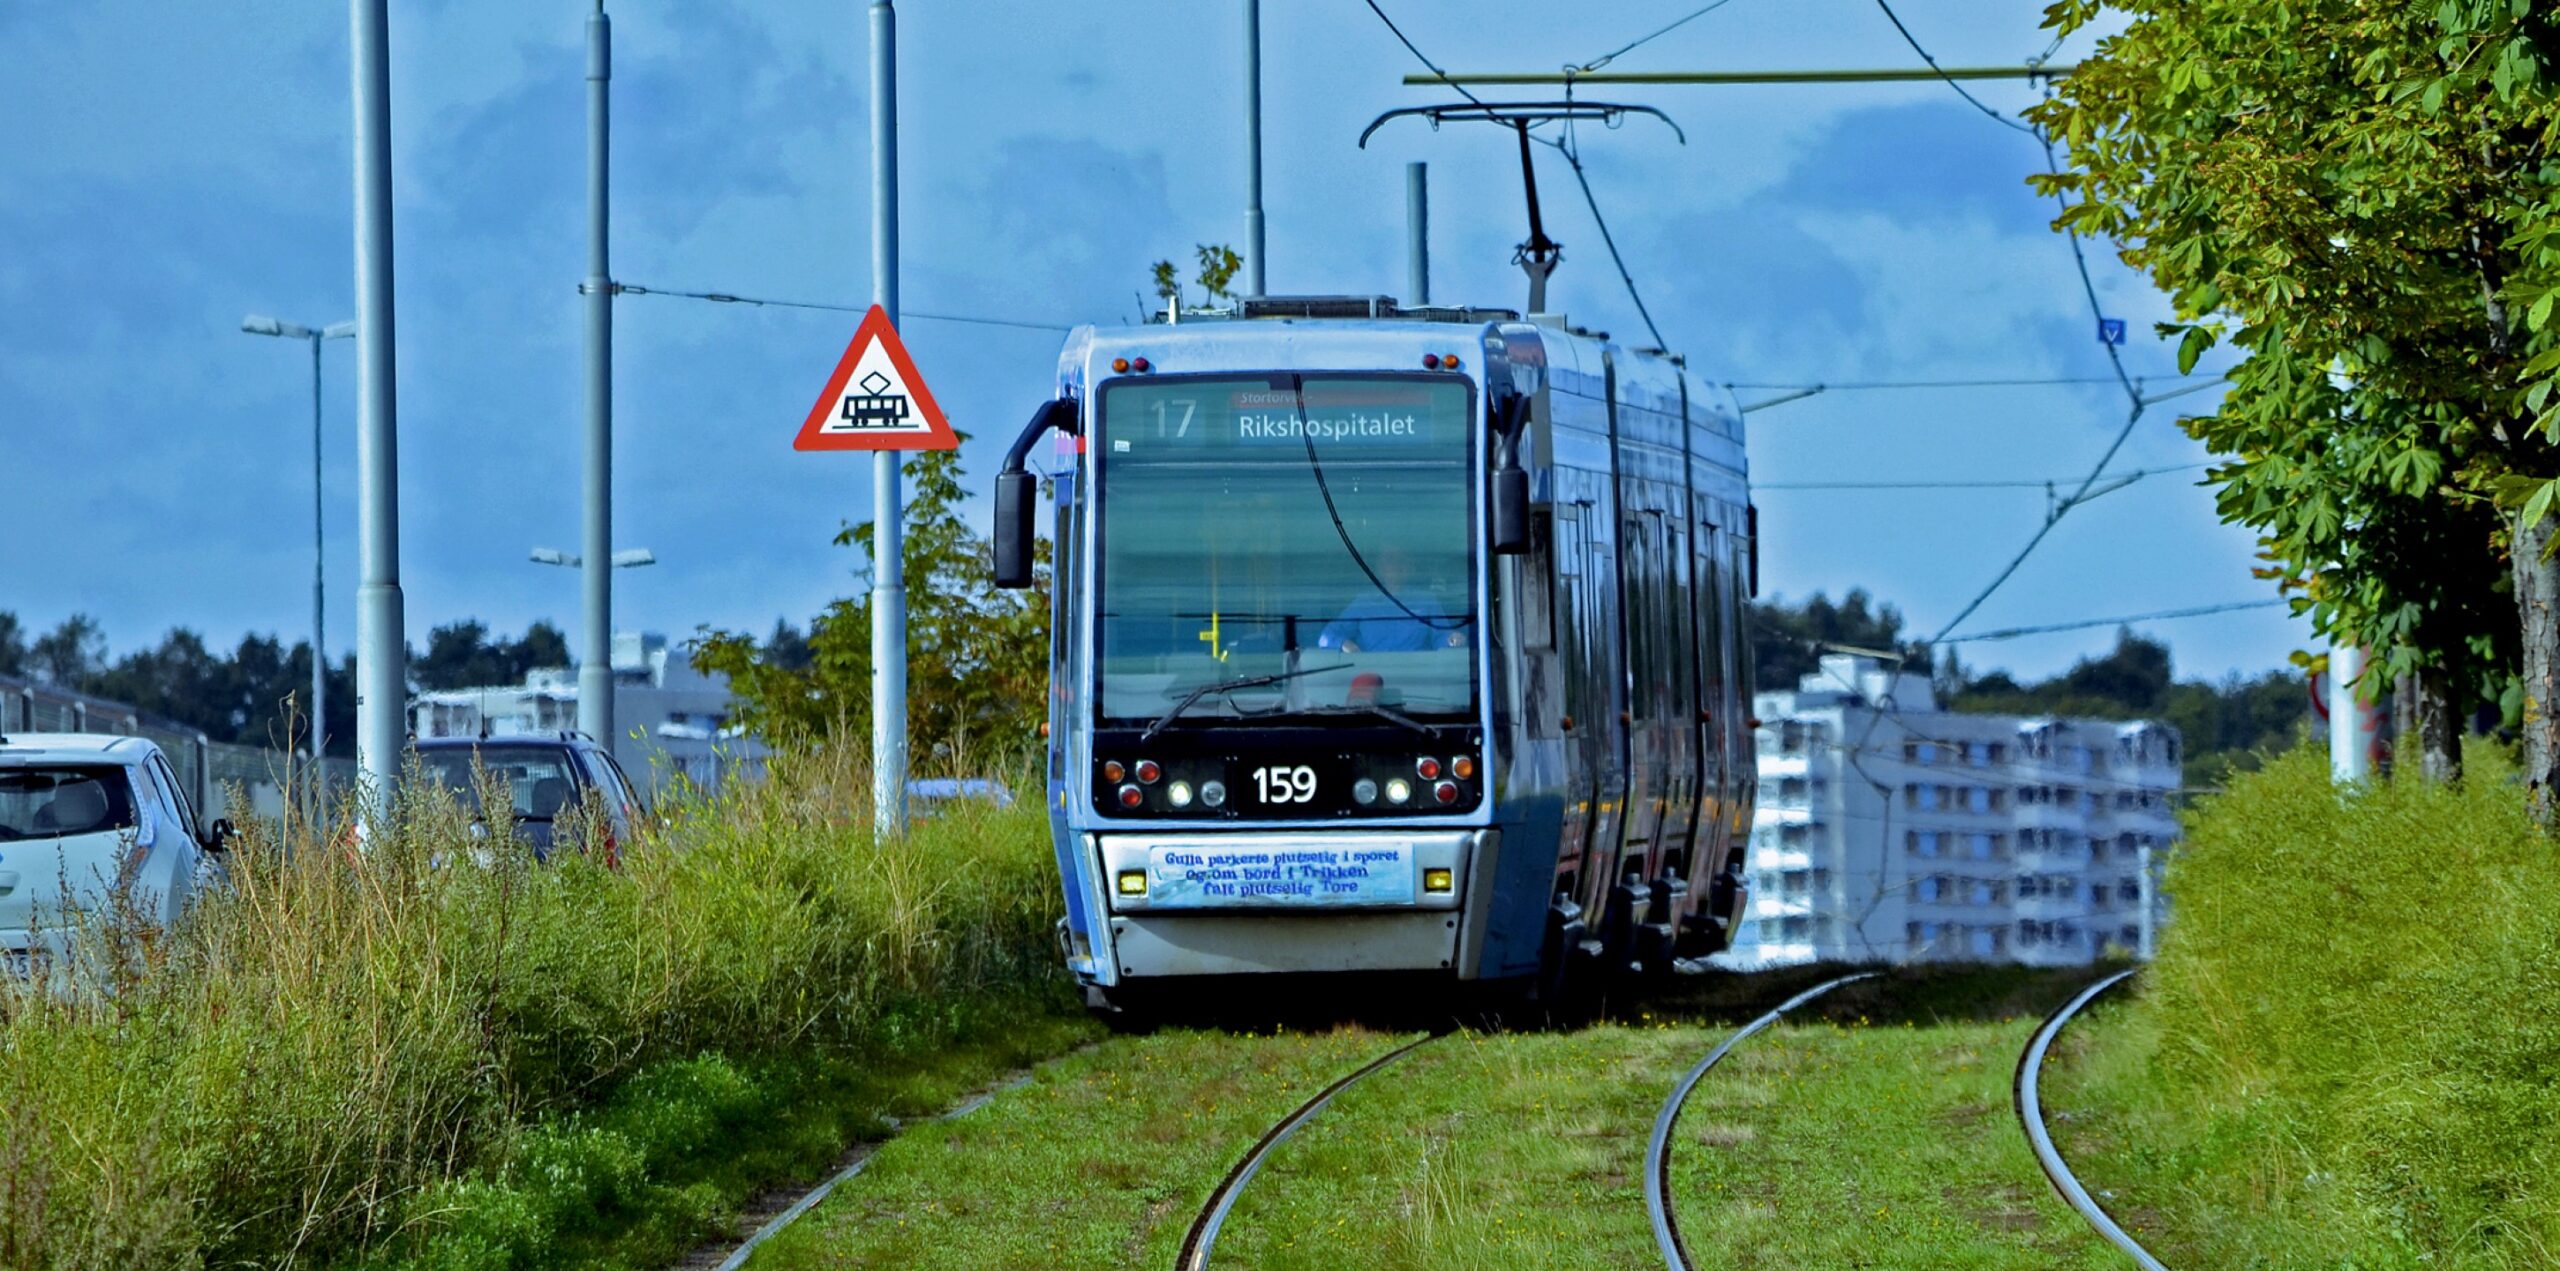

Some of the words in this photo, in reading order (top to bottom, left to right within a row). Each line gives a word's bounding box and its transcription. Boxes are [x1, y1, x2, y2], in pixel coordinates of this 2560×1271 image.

[1151, 399, 1197, 438] 17
[1239, 412, 1416, 442] Rikshospitalet
[1253, 765, 1317, 804] 159
[1208, 854, 1270, 867] parkerte
[1273, 852, 1338, 866] plutselig
[1353, 850, 1400, 864] sporet
[1243, 865, 1281, 880] bord
[1301, 865, 1369, 879] Trikken
[1240, 881, 1313, 897] plutselig
[1322, 880, 1359, 893] Tore
